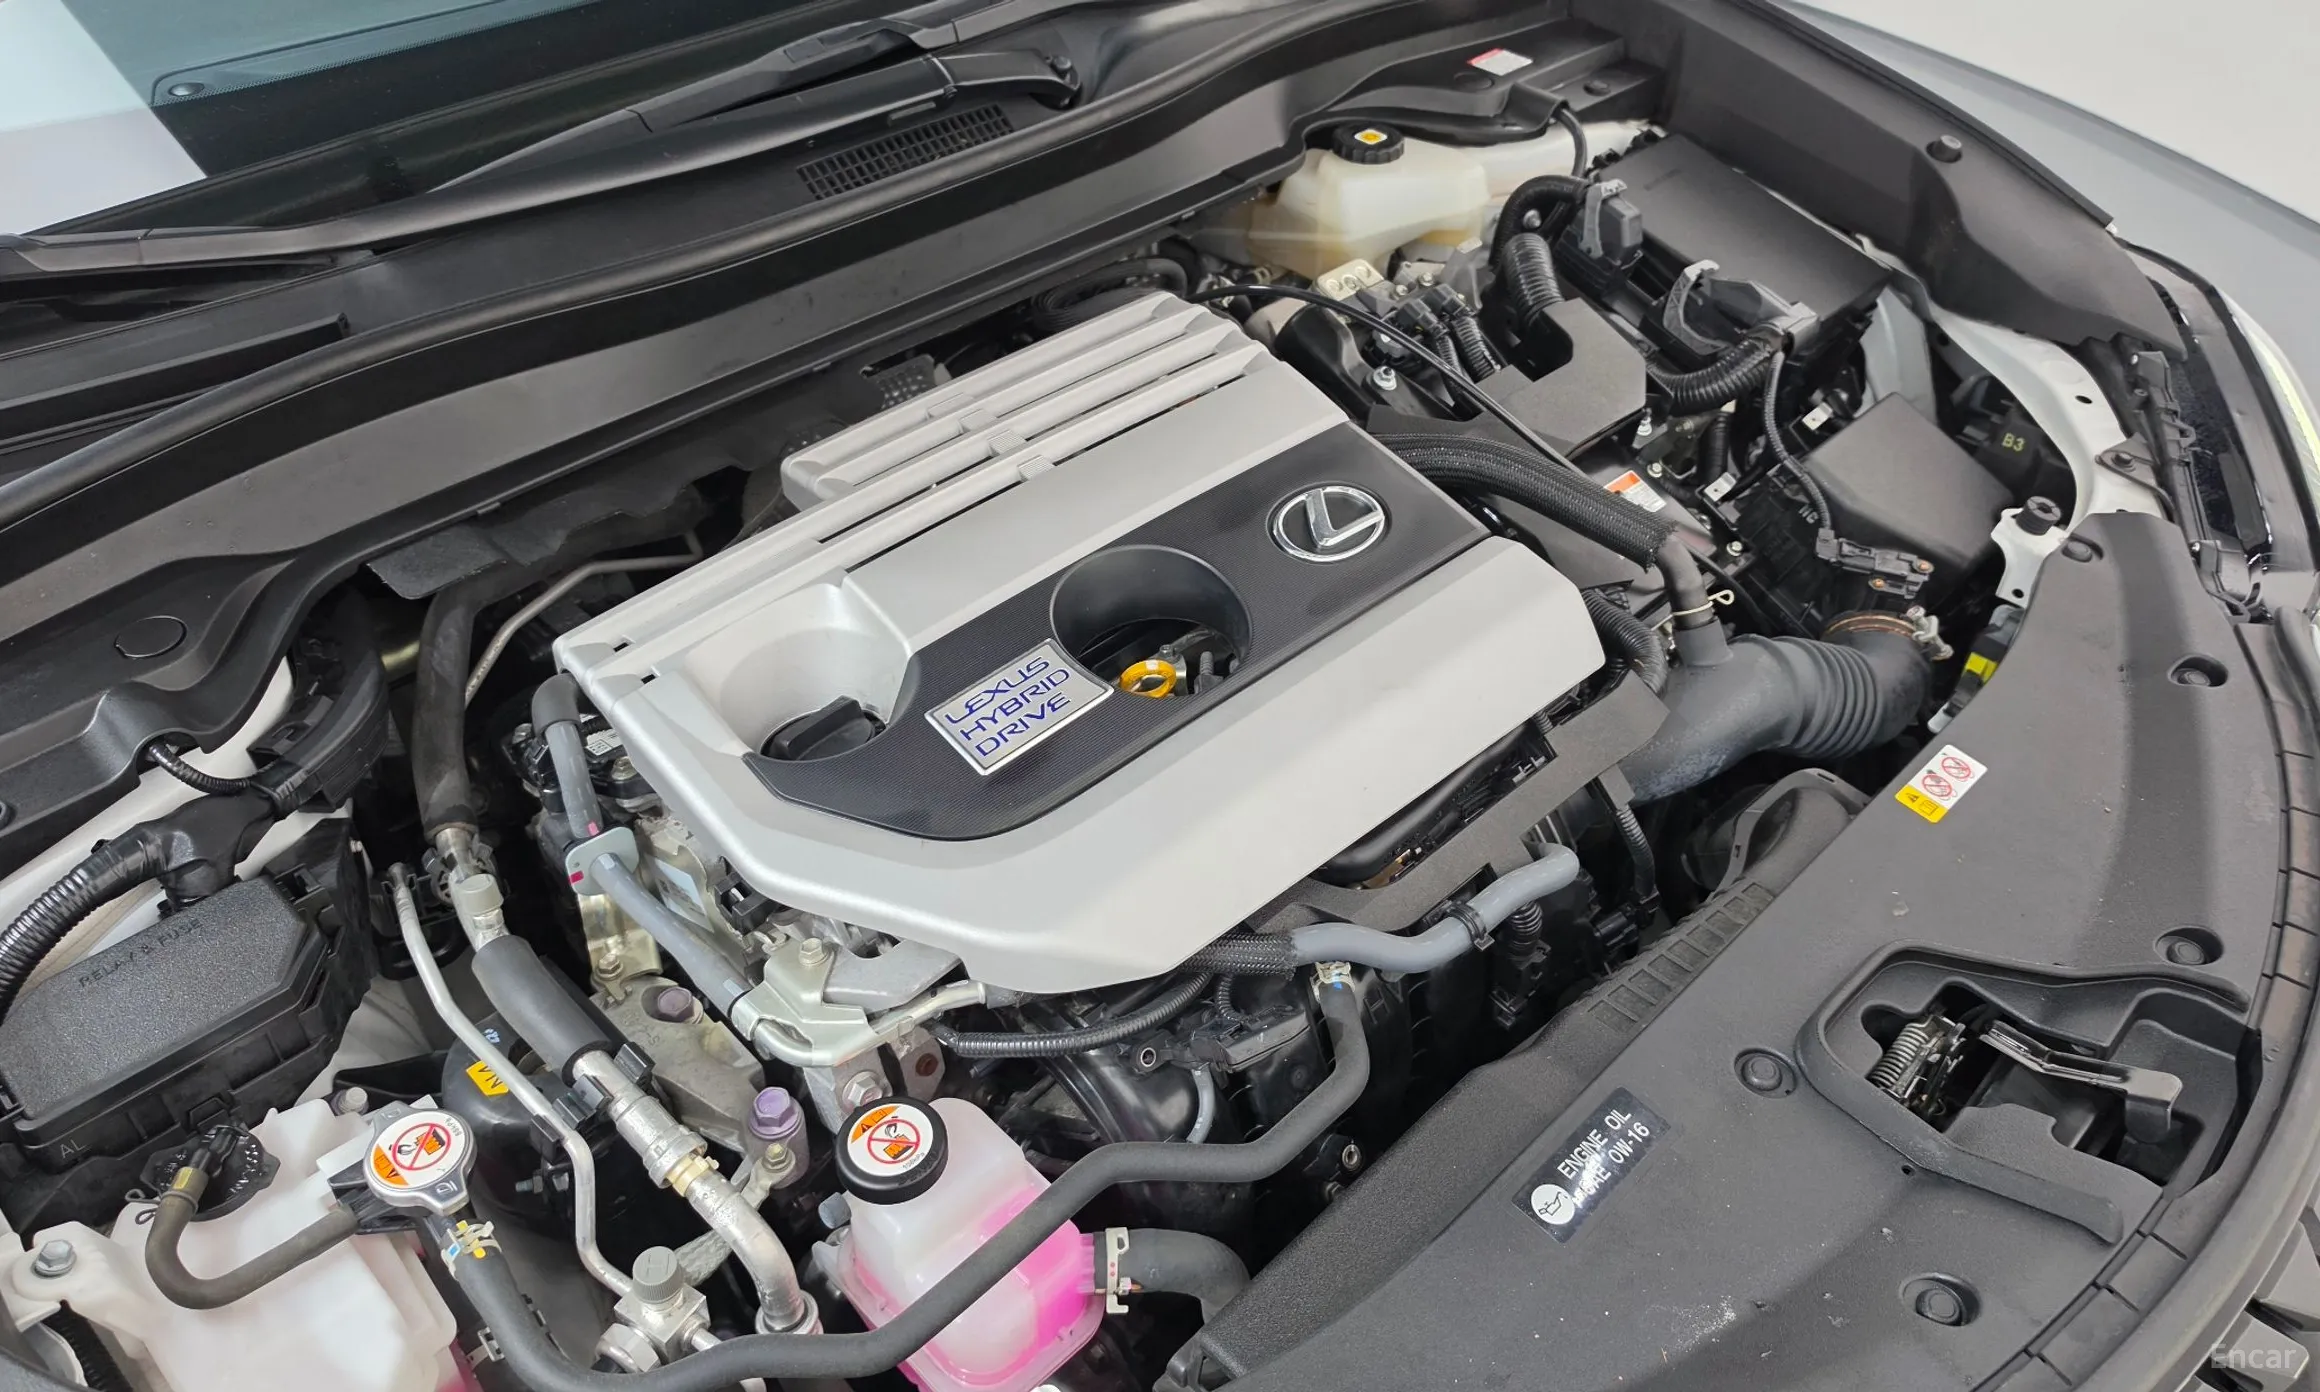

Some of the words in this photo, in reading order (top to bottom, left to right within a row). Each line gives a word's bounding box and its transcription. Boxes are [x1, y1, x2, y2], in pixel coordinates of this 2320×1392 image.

[2001, 432, 2026, 452] B3
[945, 656, 1050, 724] LEXUS
[960, 668, 1070, 741] HYBRID
[975, 692, 1071, 757] DRIVE
[1557, 1128, 1609, 1180] ENGINE
[1604, 1109, 1632, 1131] OIL
